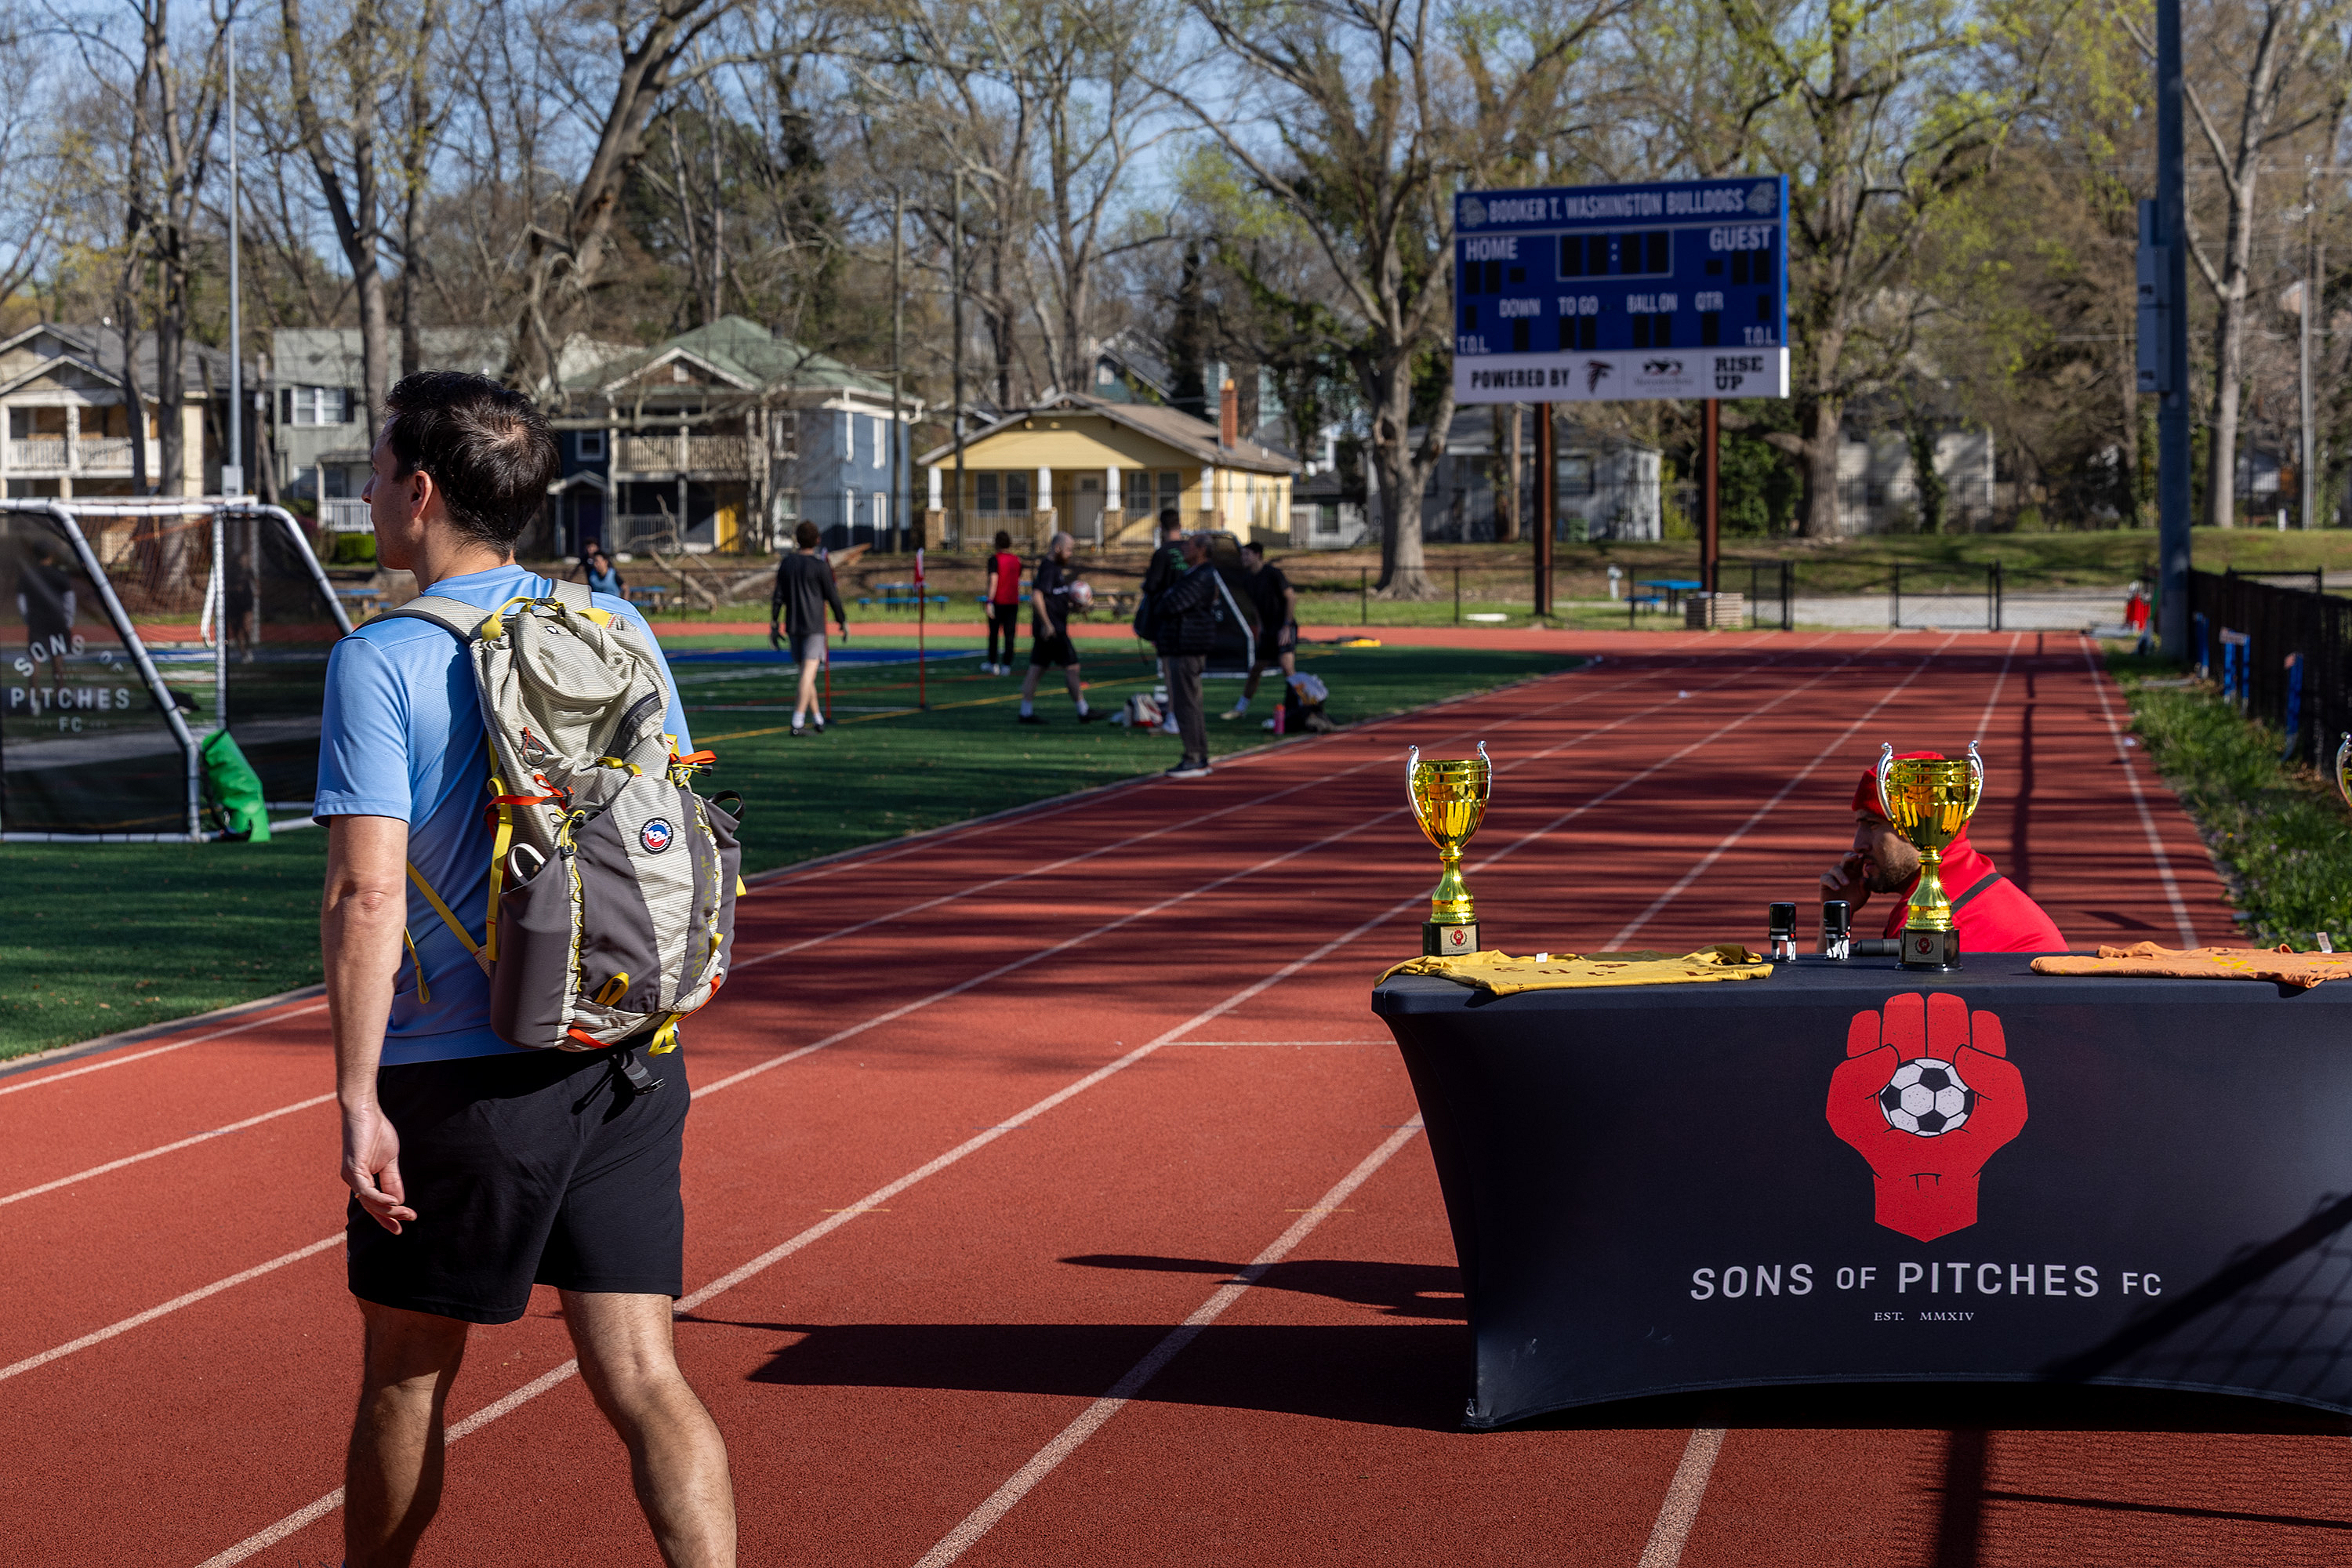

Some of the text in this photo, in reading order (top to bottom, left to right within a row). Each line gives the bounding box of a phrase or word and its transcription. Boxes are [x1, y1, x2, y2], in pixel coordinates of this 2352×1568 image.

[1489, 187, 1744, 223] BOOKER T. WASHINGTON BULLDOGS
[1465, 237, 1519, 261] HOME
[1709, 225, 1773, 252] GUEST
[1499, 297, 1541, 318] DOWN
[1557, 295, 1599, 316] TO GO
[1626, 292, 1679, 314] BALL ON
[1695, 291, 1724, 312] QTR
[1715, 356, 1763, 373] RISE
[1471, 367, 1570, 390] POWERED BY
[1715, 375, 1744, 391] UP
[13, 633, 85, 677] SONS
[10, 687, 130, 710] PITCHES
[59, 717, 82, 733] FC
[1690, 1262, 2161, 1301] SONS OF PITCHES FC
[1873, 1312, 1975, 1321] EST. MMXIV
